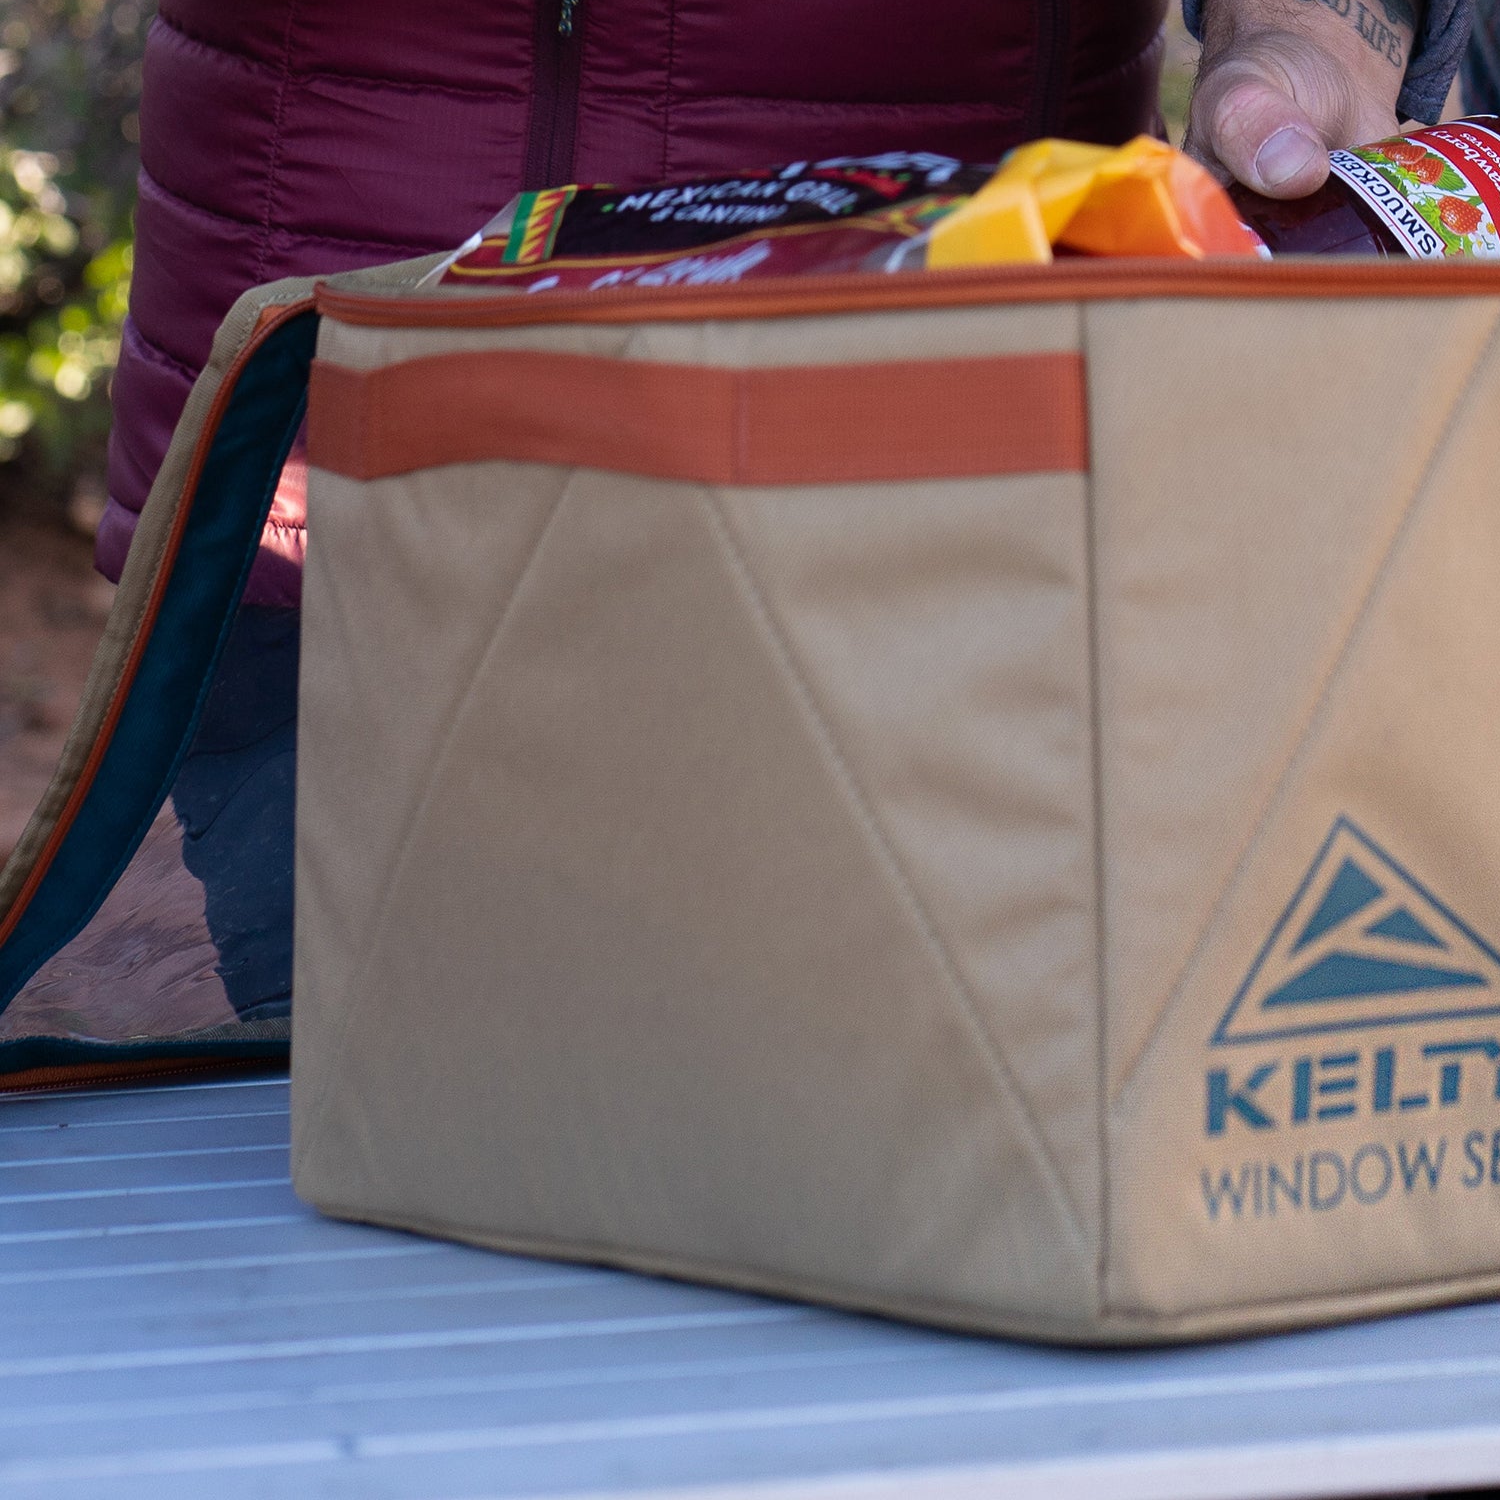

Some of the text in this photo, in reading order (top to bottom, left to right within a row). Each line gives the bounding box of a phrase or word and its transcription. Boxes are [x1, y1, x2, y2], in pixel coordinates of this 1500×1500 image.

[1352, 1, 1402, 68] LIFE
[616, 180, 787, 213] MEXICAN
[1203, 1138, 1448, 1221] WINDOW
